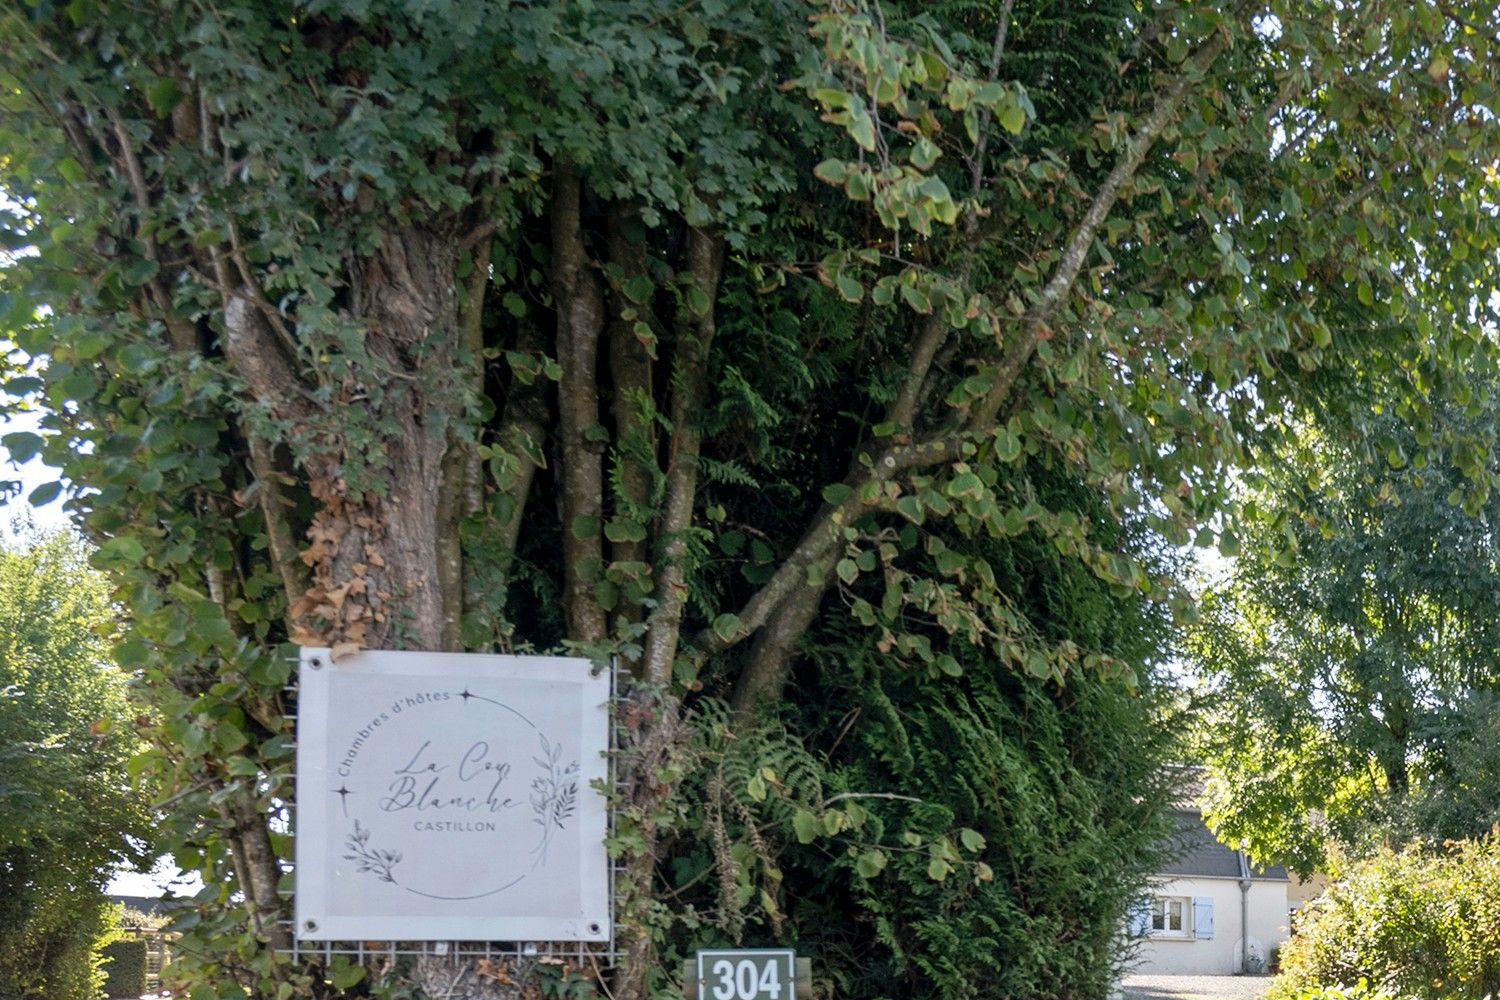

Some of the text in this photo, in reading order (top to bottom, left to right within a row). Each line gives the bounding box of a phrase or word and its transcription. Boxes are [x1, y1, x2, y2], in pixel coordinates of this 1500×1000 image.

[338, 691, 451, 777] Chambres d'hôtes
[394, 740, 449, 775] La
[380, 776, 523, 812] Blanche
[414, 821, 496, 832] CASTILLON
[712, 959, 781, 1000] 304
